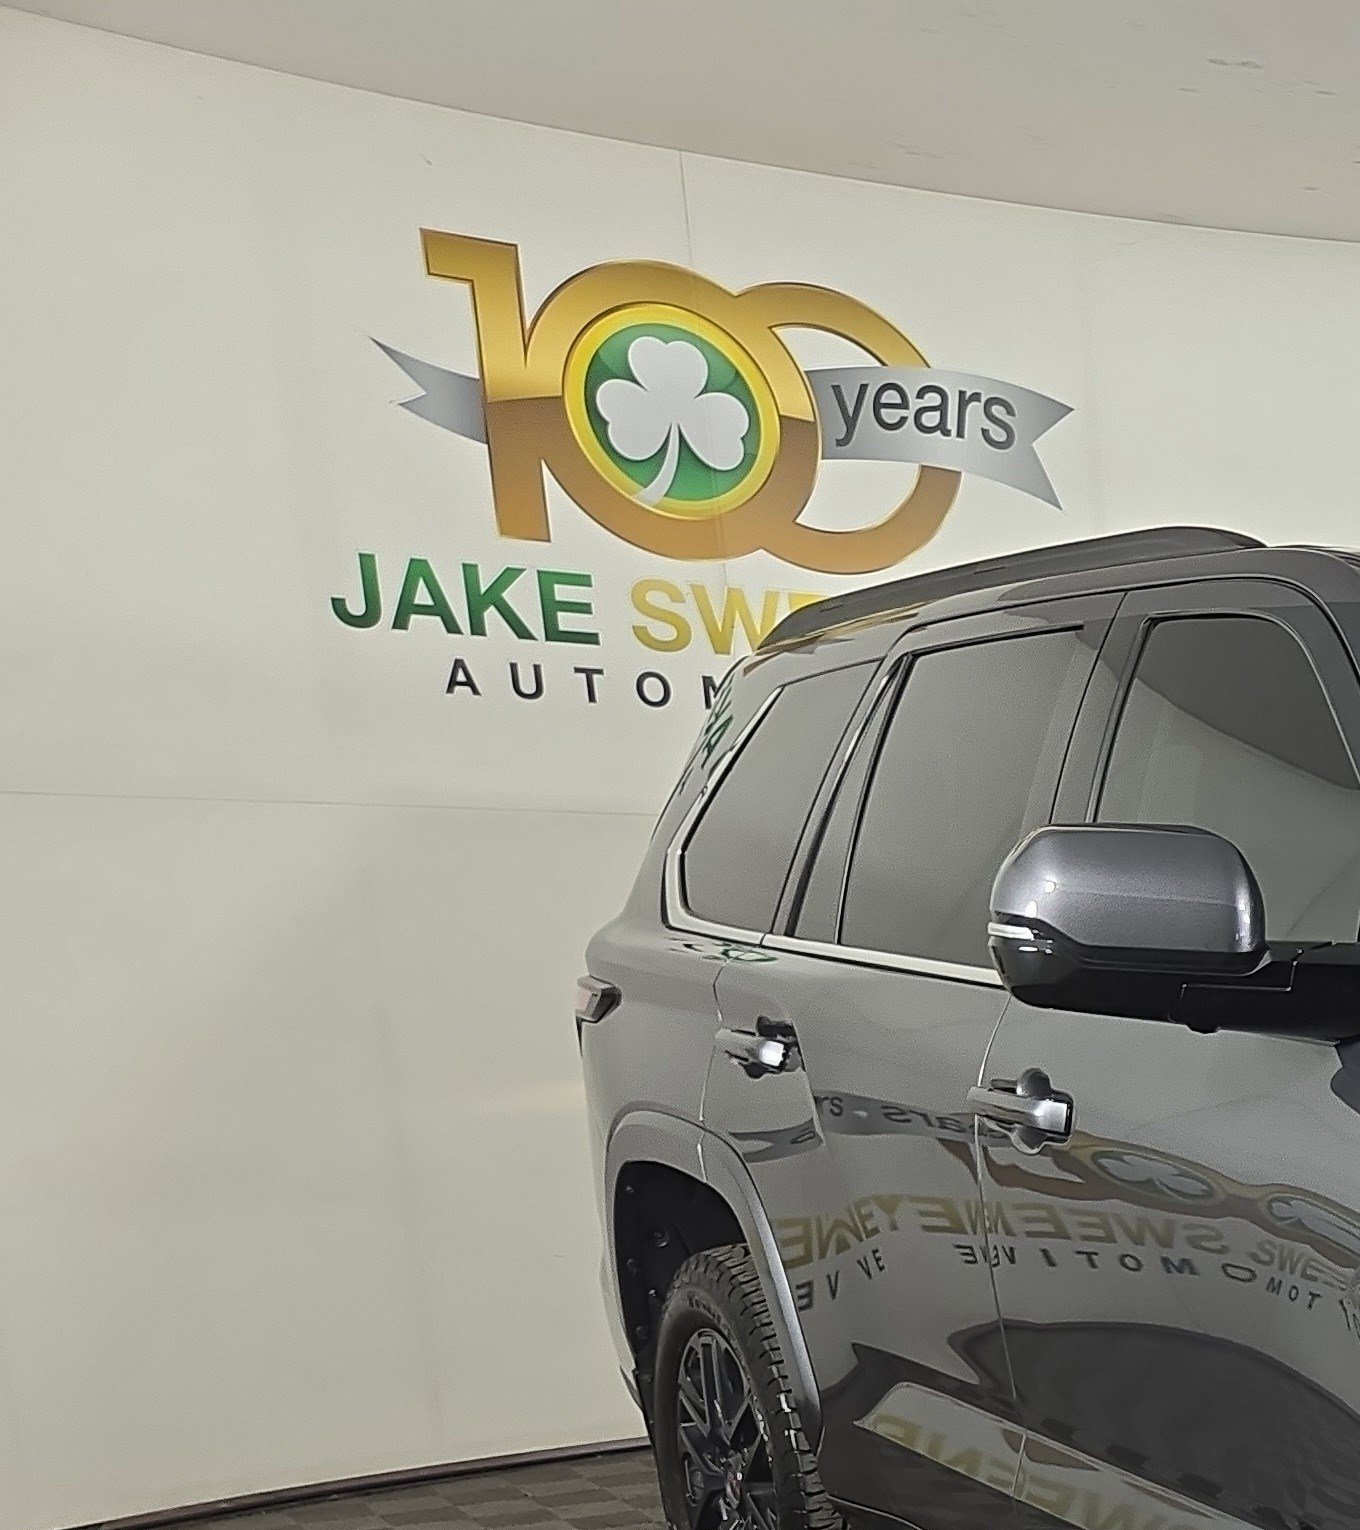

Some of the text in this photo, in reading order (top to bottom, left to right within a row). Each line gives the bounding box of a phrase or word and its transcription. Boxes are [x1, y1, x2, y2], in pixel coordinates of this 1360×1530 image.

[420, 228, 962, 574] 100
[831, 379, 1017, 451] years
[331, 553, 601, 645] JAKE
